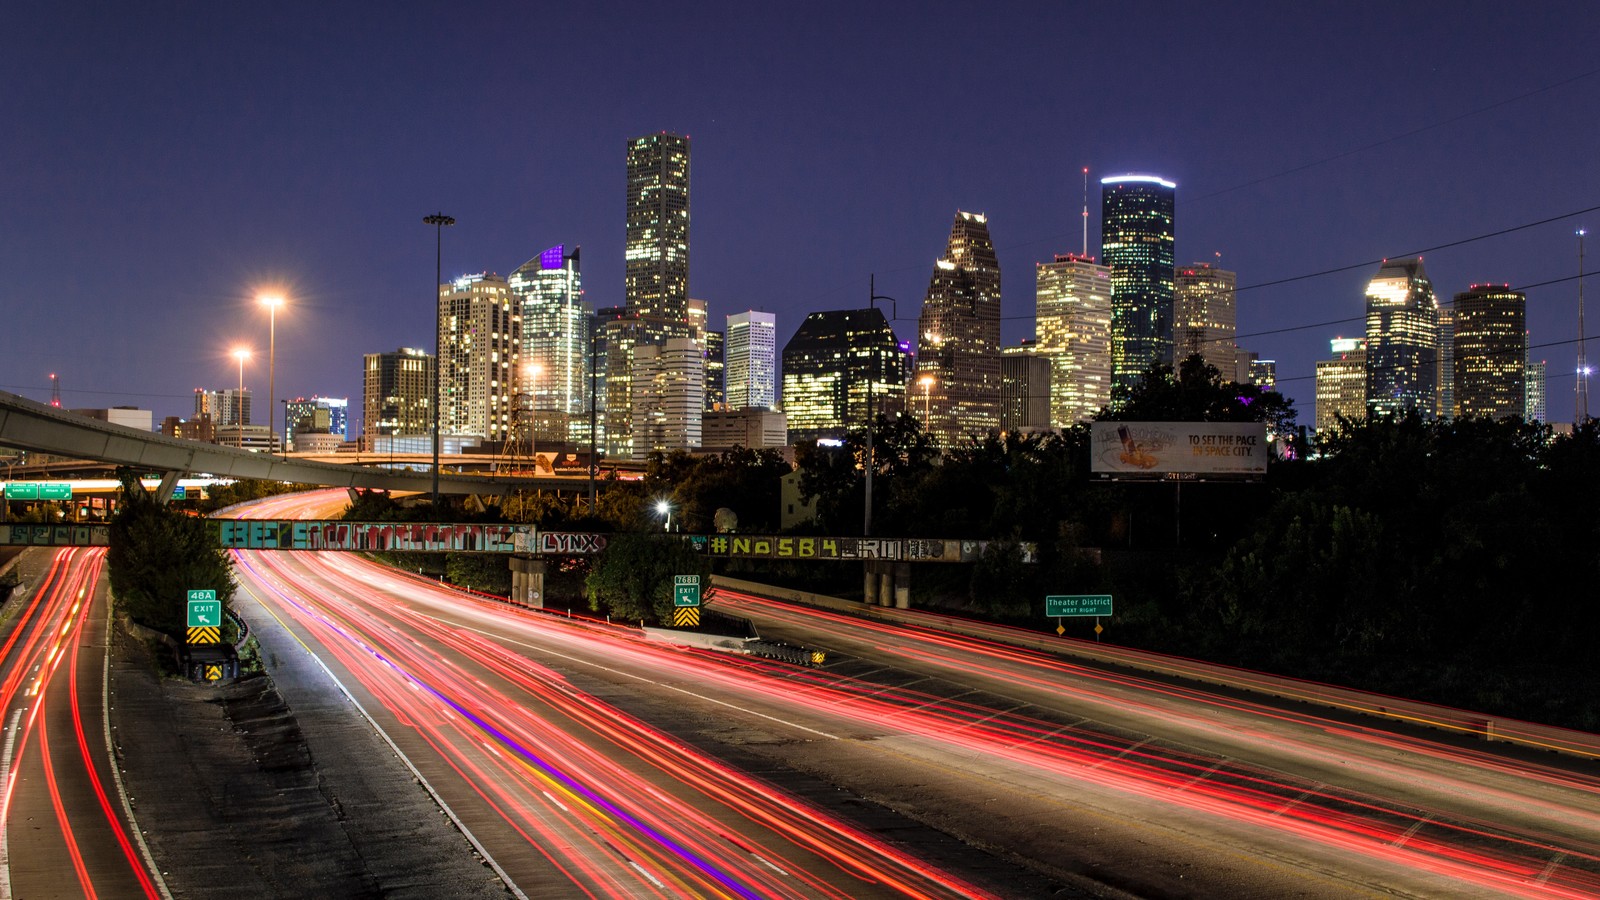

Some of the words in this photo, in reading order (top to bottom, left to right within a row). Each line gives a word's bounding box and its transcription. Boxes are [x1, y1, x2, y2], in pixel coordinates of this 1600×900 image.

[1188, 435, 1199, 445] TO
[1202, 435, 1216, 445] SET
[1218, 435, 1233, 446] THE
[1236, 436, 1256, 446] PACE
[1193, 446, 1202, 456] IN
[1205, 446, 1230, 456] SPACE
[1233, 446, 1252, 457] CITY.
[542, 533, 600, 553] LYNX
[678, 576, 697, 584] 768B
[190, 592, 212, 600] 48A
[1081, 598, 1110, 606] District
